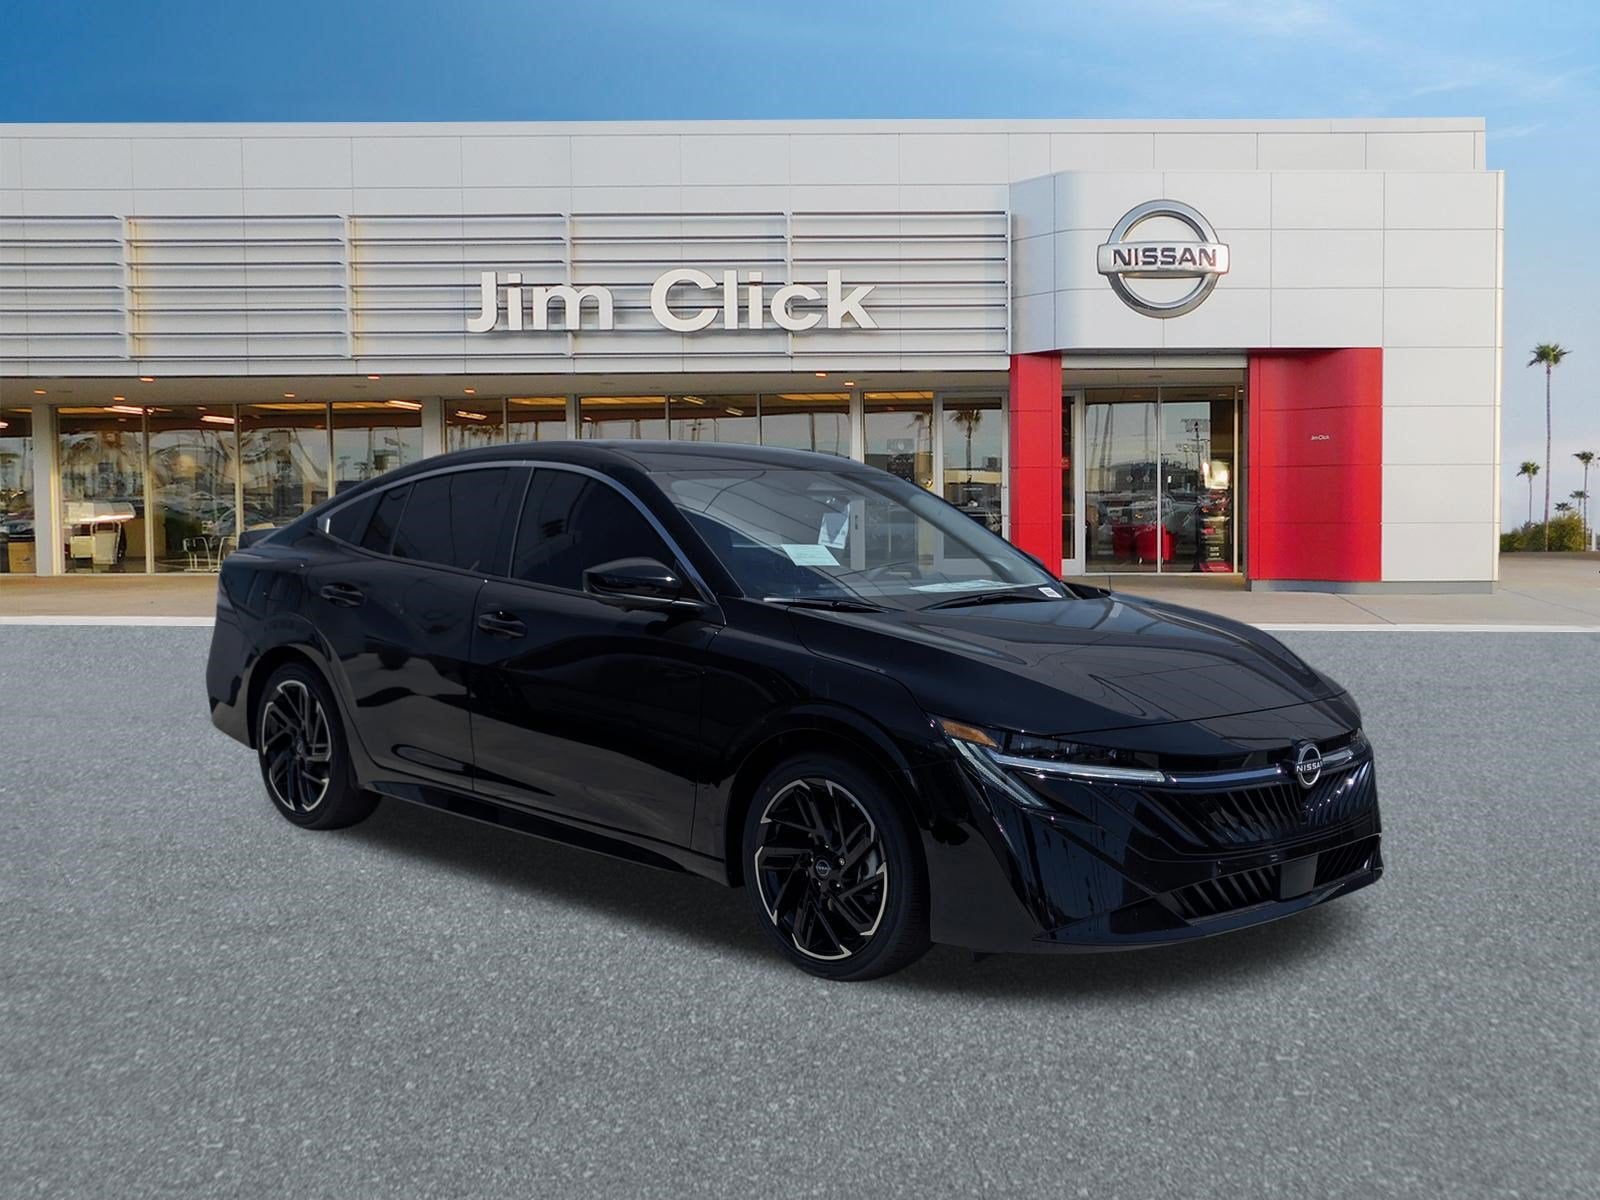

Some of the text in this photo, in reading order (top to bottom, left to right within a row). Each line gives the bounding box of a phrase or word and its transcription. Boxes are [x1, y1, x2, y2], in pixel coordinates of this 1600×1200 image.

[1112, 247, 1217, 267] NISSAN
[467, 268, 880, 333] Jim Click
